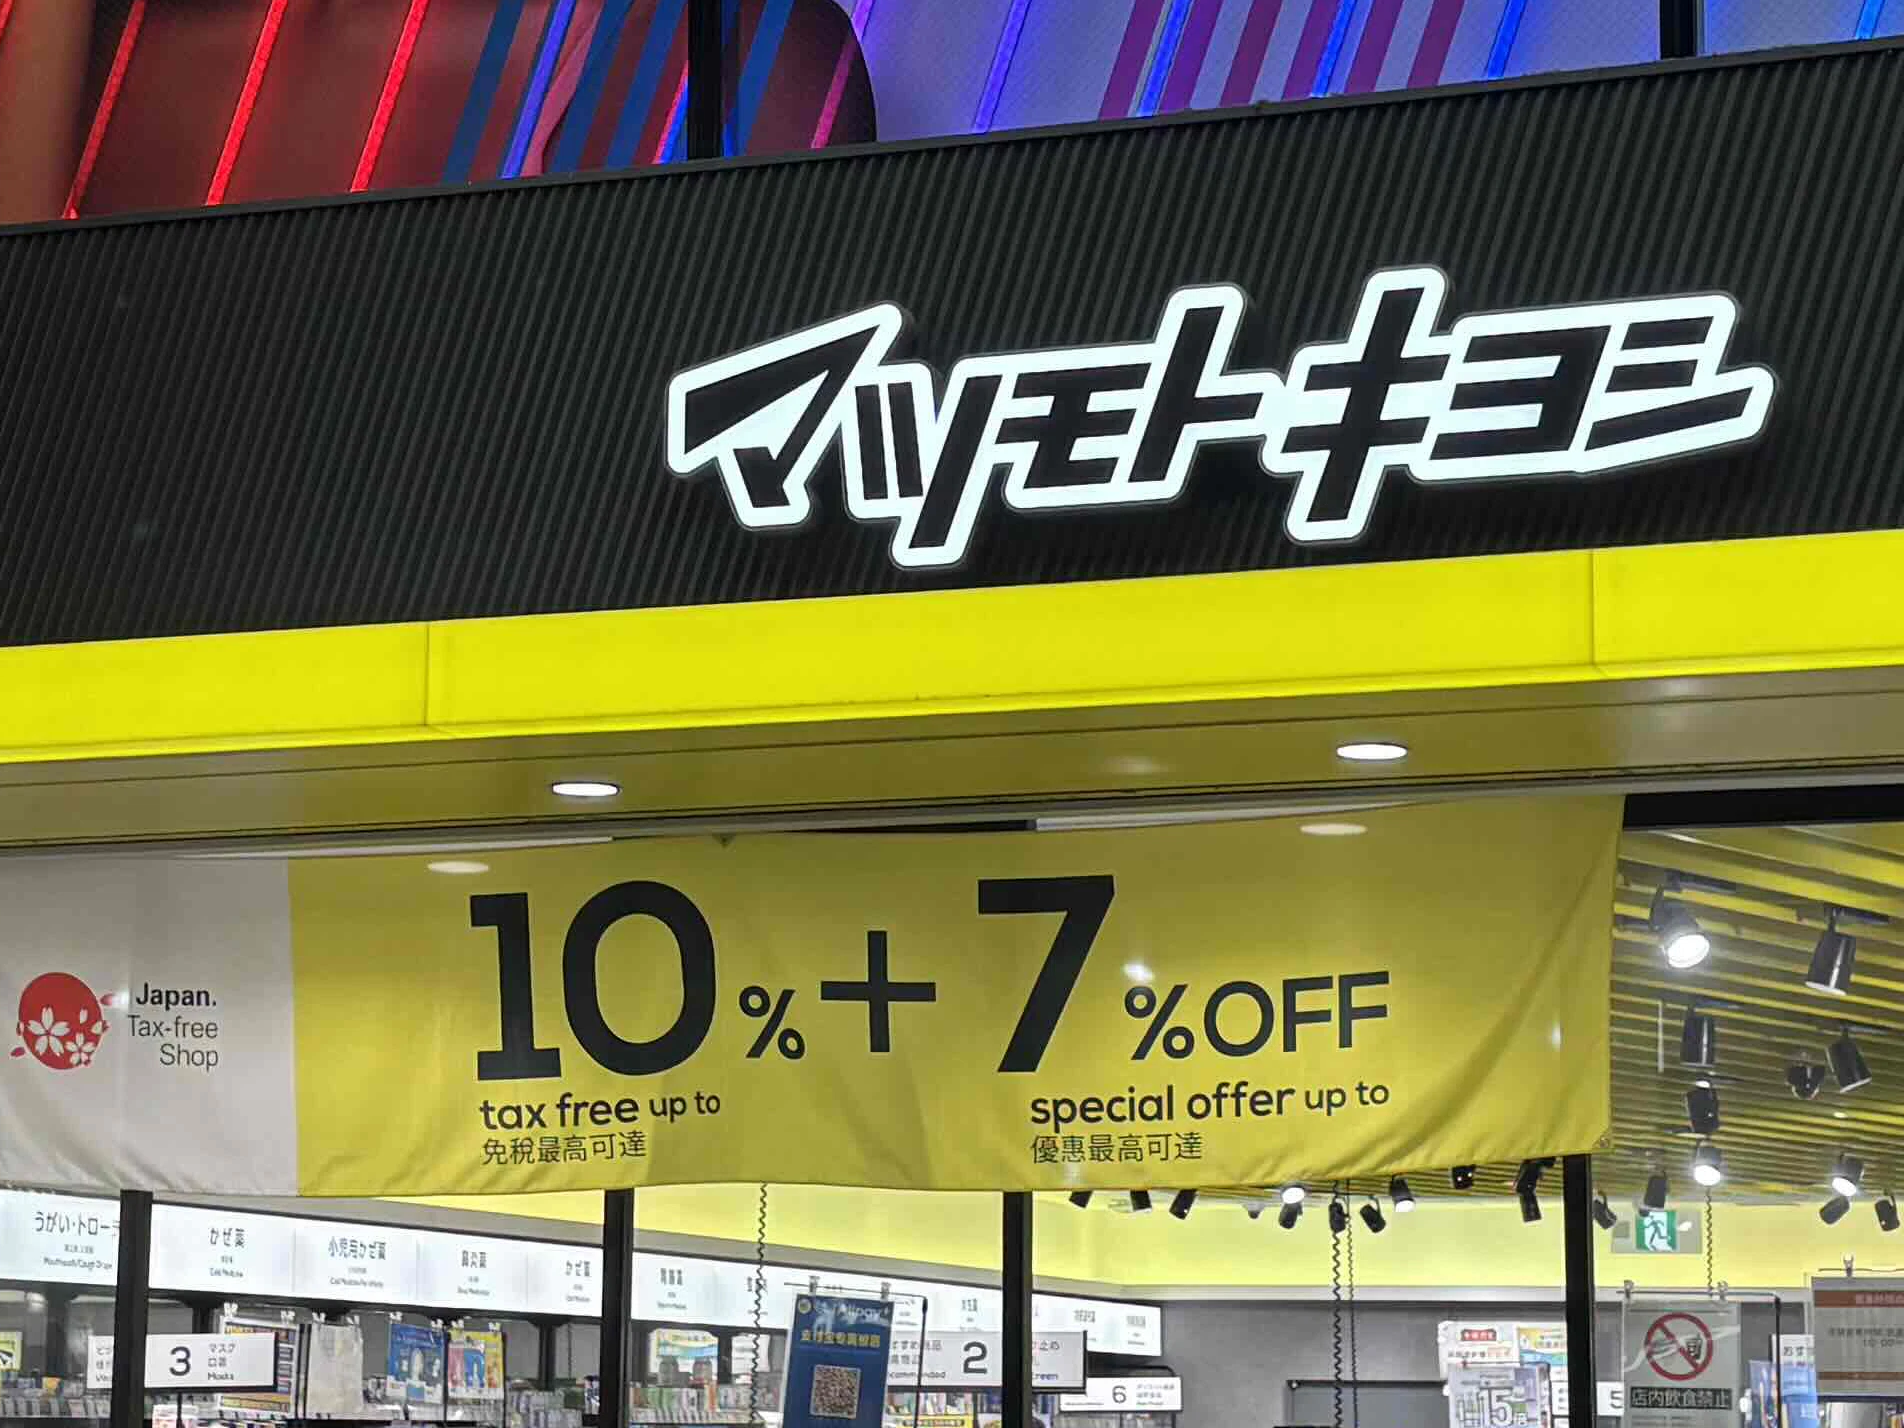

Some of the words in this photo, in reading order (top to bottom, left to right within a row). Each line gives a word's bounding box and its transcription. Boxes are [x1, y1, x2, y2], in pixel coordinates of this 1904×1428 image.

[664, 266, 1780, 566] マツモトキヨシ
[135, 982, 218, 1012] Japan.
[128, 1015, 219, 1040] Tax-free
[159, 1043, 219, 1071] Shop
[479, 1099, 545, 1130] tax
[555, 1093, 640, 1128] free
[649, 1097, 690, 1124] up
[695, 1091, 722, 1117] to
[1030, 1085, 1175, 1136] special
[1185, 1081, 1296, 1122] offer
[1305, 1083, 1347, 1117] up
[1356, 1079, 1390, 1107] to
[169, 1346, 192, 1376] 3
[208, 1342, 236, 1353] マスク
[963, 1341, 988, 1375] 2
[1112, 1385, 1127, 1404] 6
[1632, 1387, 1730, 1408] 店内飲食禁止
